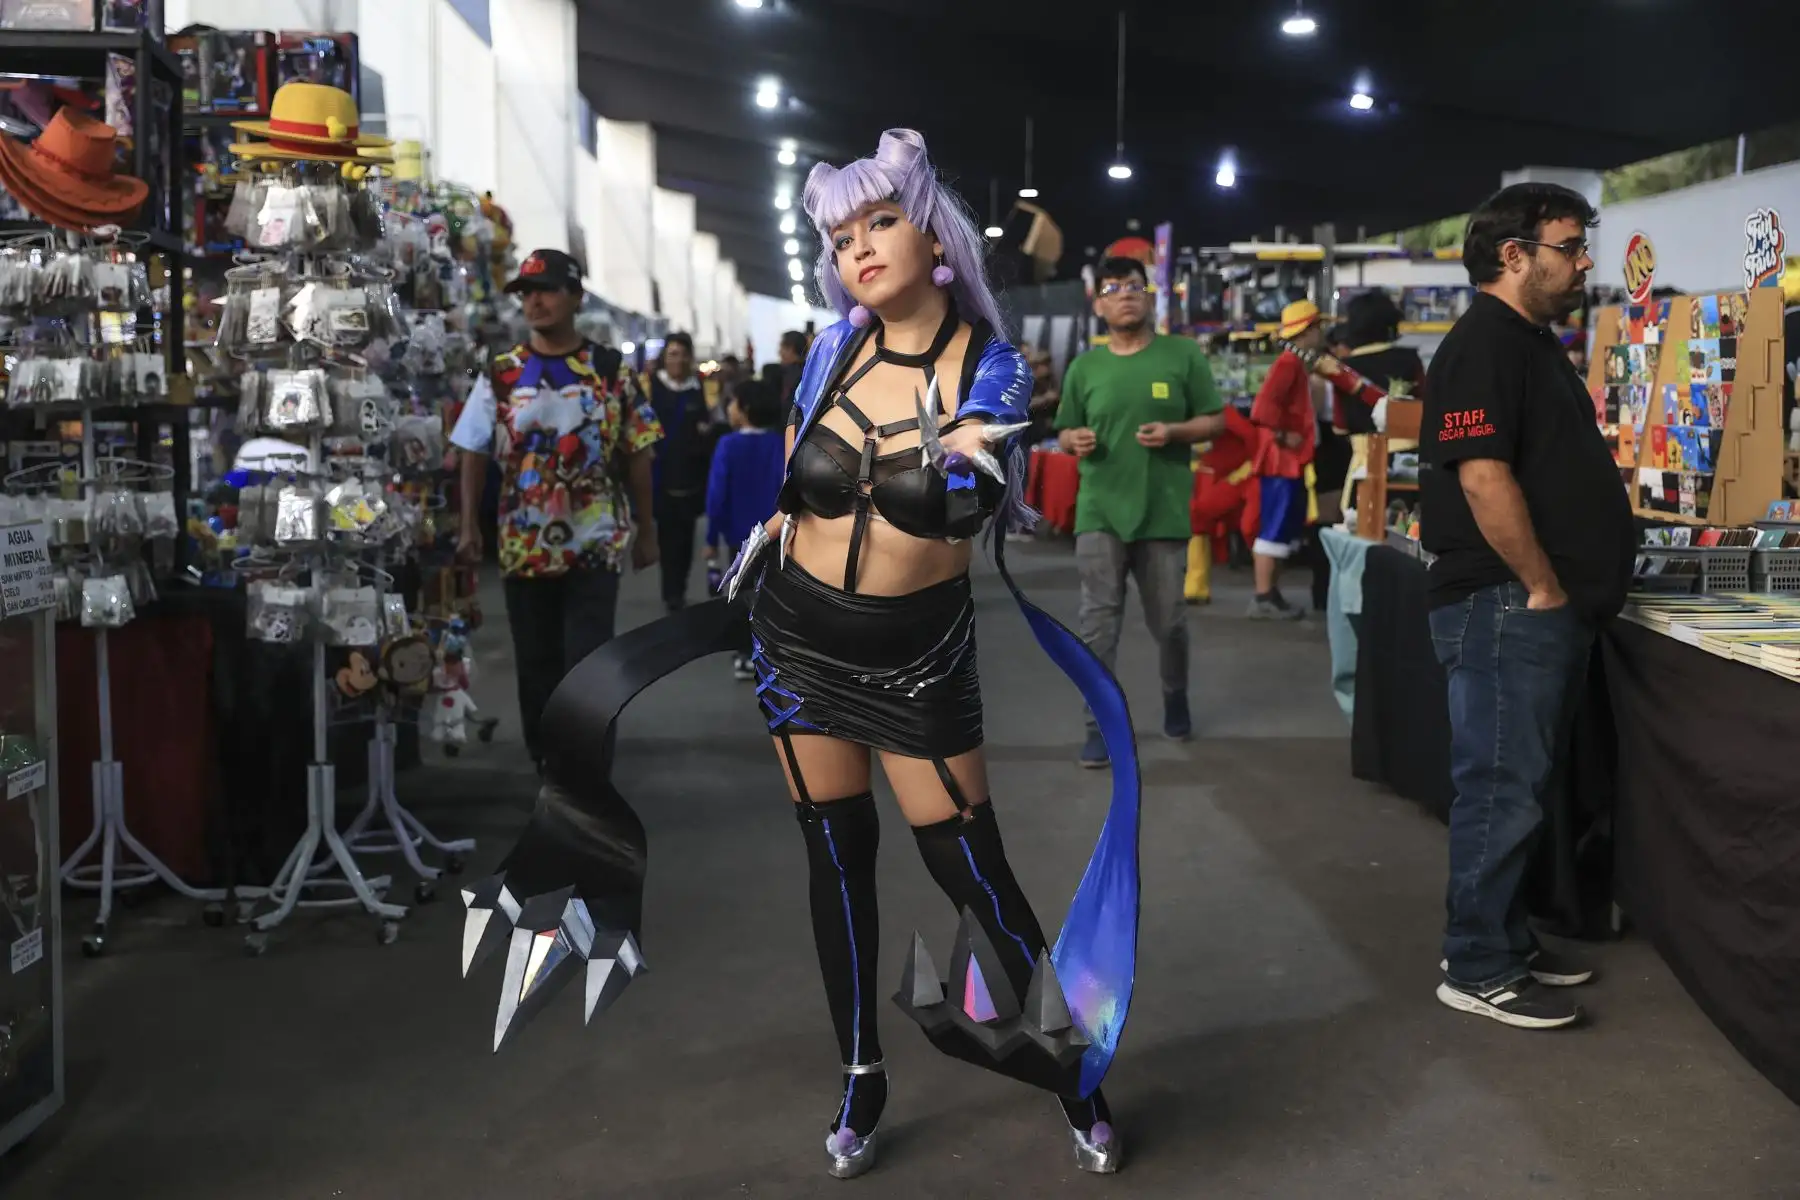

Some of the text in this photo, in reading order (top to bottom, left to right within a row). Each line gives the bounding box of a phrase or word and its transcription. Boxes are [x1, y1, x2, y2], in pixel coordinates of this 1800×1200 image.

[1625, 238, 1656, 294] UNO
[1444, 408, 1485, 429] STAFF
[1438, 424, 1496, 441] OSCAR MIGUEL
[7, 529, 35, 546] AGUA
[3, 547, 46, 568] MINERAL
[1, 573, 14, 584] SAN
[4, 586, 21, 598] CIELO
[7, 600, 19, 612] SAN
